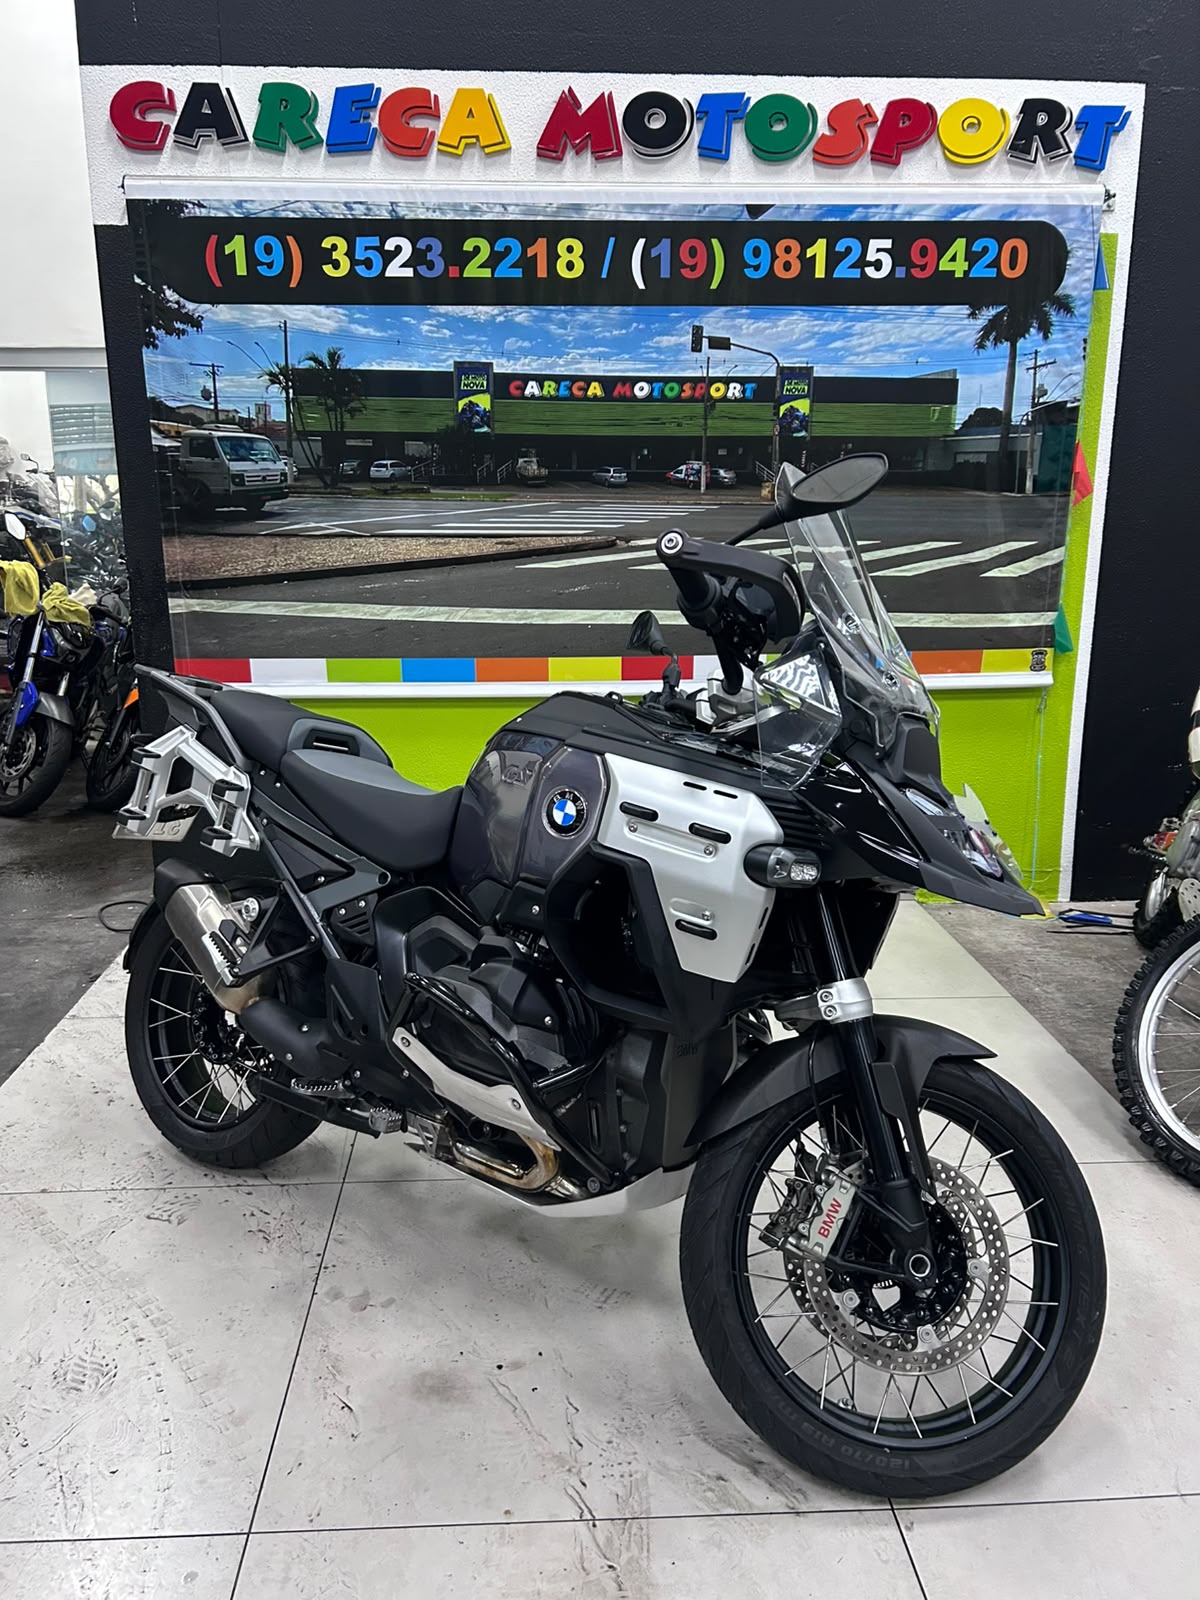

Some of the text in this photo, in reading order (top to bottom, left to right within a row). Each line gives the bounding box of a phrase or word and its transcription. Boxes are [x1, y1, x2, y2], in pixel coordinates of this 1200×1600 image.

[109, 80, 1131, 171] CARECA MOTOSPORT
[205, 234, 1028, 289] (19) 3523.2218 / (19) 98125.9420
[462, 381, 486, 389] NOVA
[509, 380, 757, 399] CARECA MOTOSPORT
[553, 792, 583, 810] BMW
[817, 1196, 842, 1239] BMW
